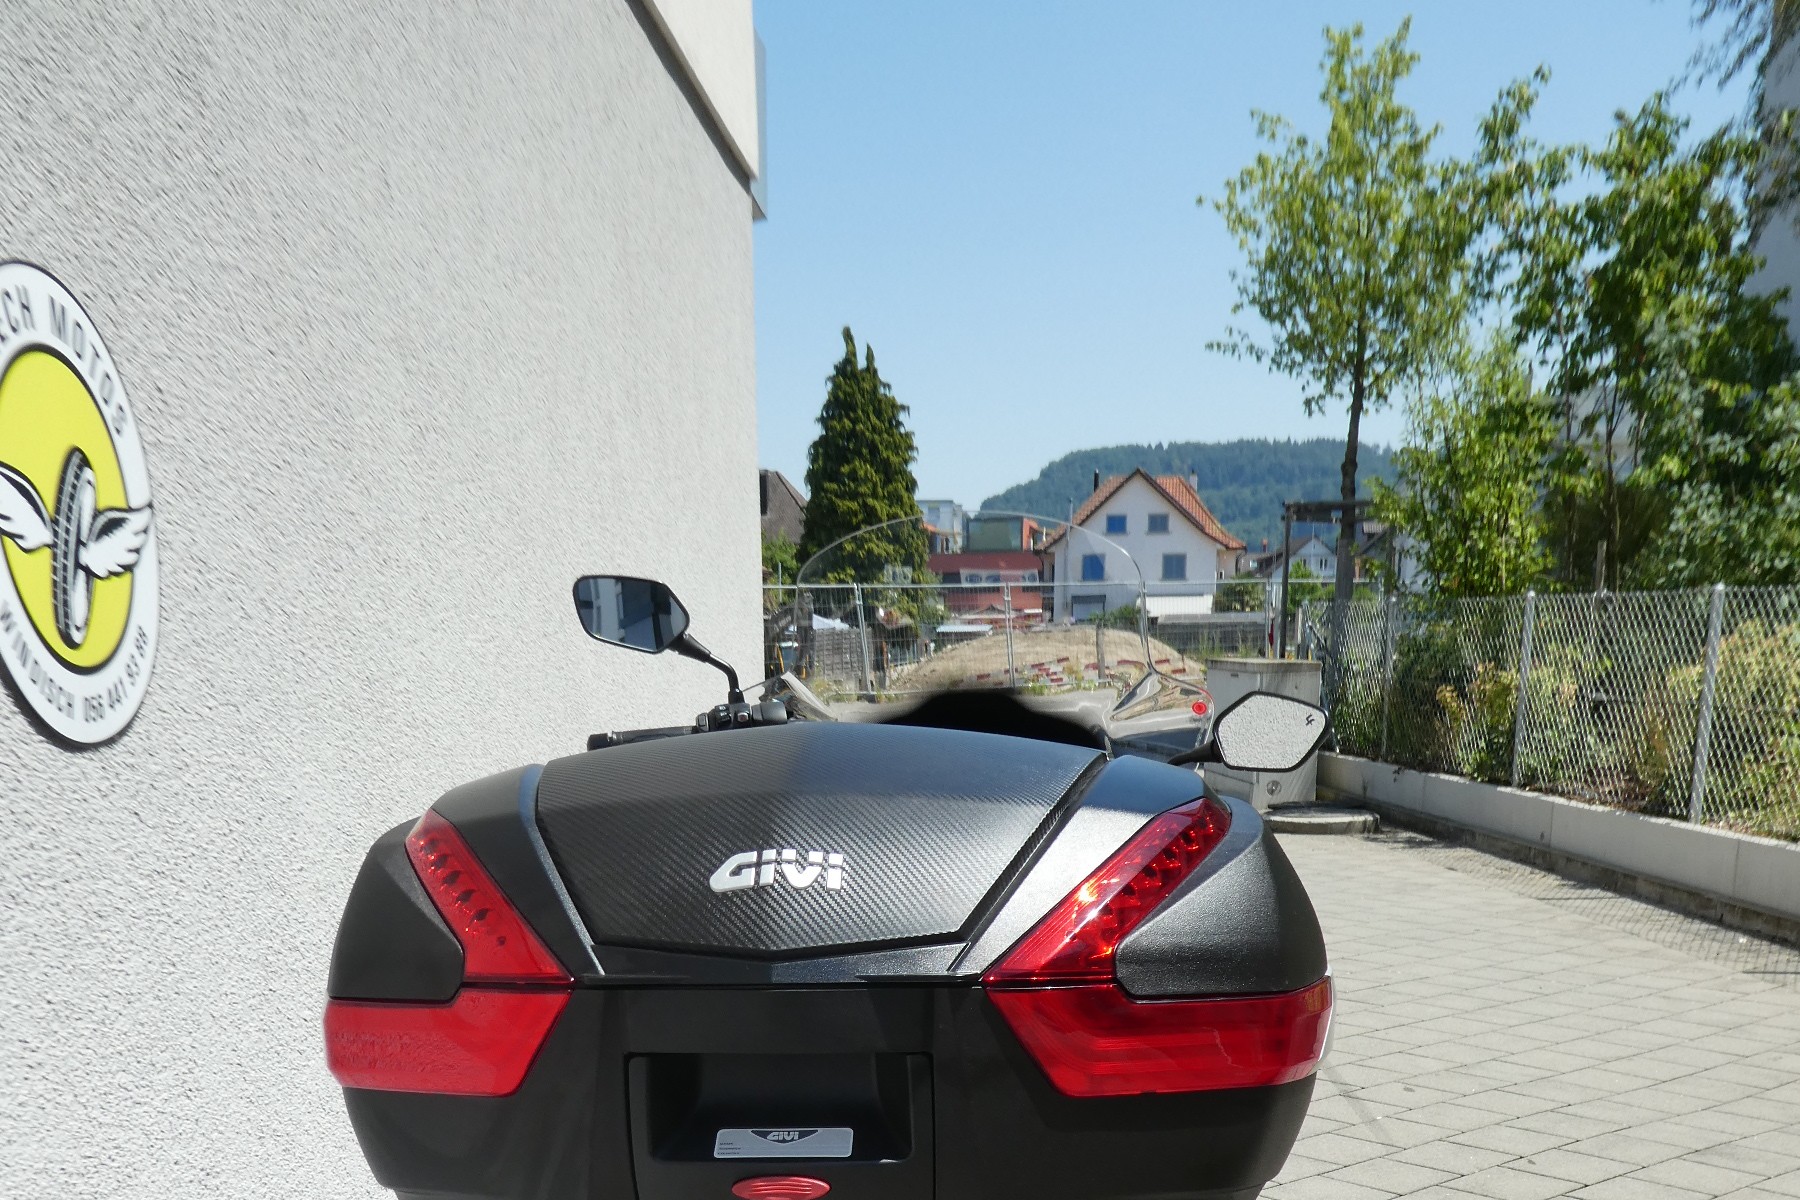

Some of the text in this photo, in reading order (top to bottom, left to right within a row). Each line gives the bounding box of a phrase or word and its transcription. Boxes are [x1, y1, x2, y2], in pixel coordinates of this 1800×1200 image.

[48, 293, 127, 438] MOTOS
[0, 600, 75, 720] WINDISCH
[107, 677, 128, 712] 441
[709, 848, 843, 893] GIVI
[766, 1131, 799, 1141] GIVI
